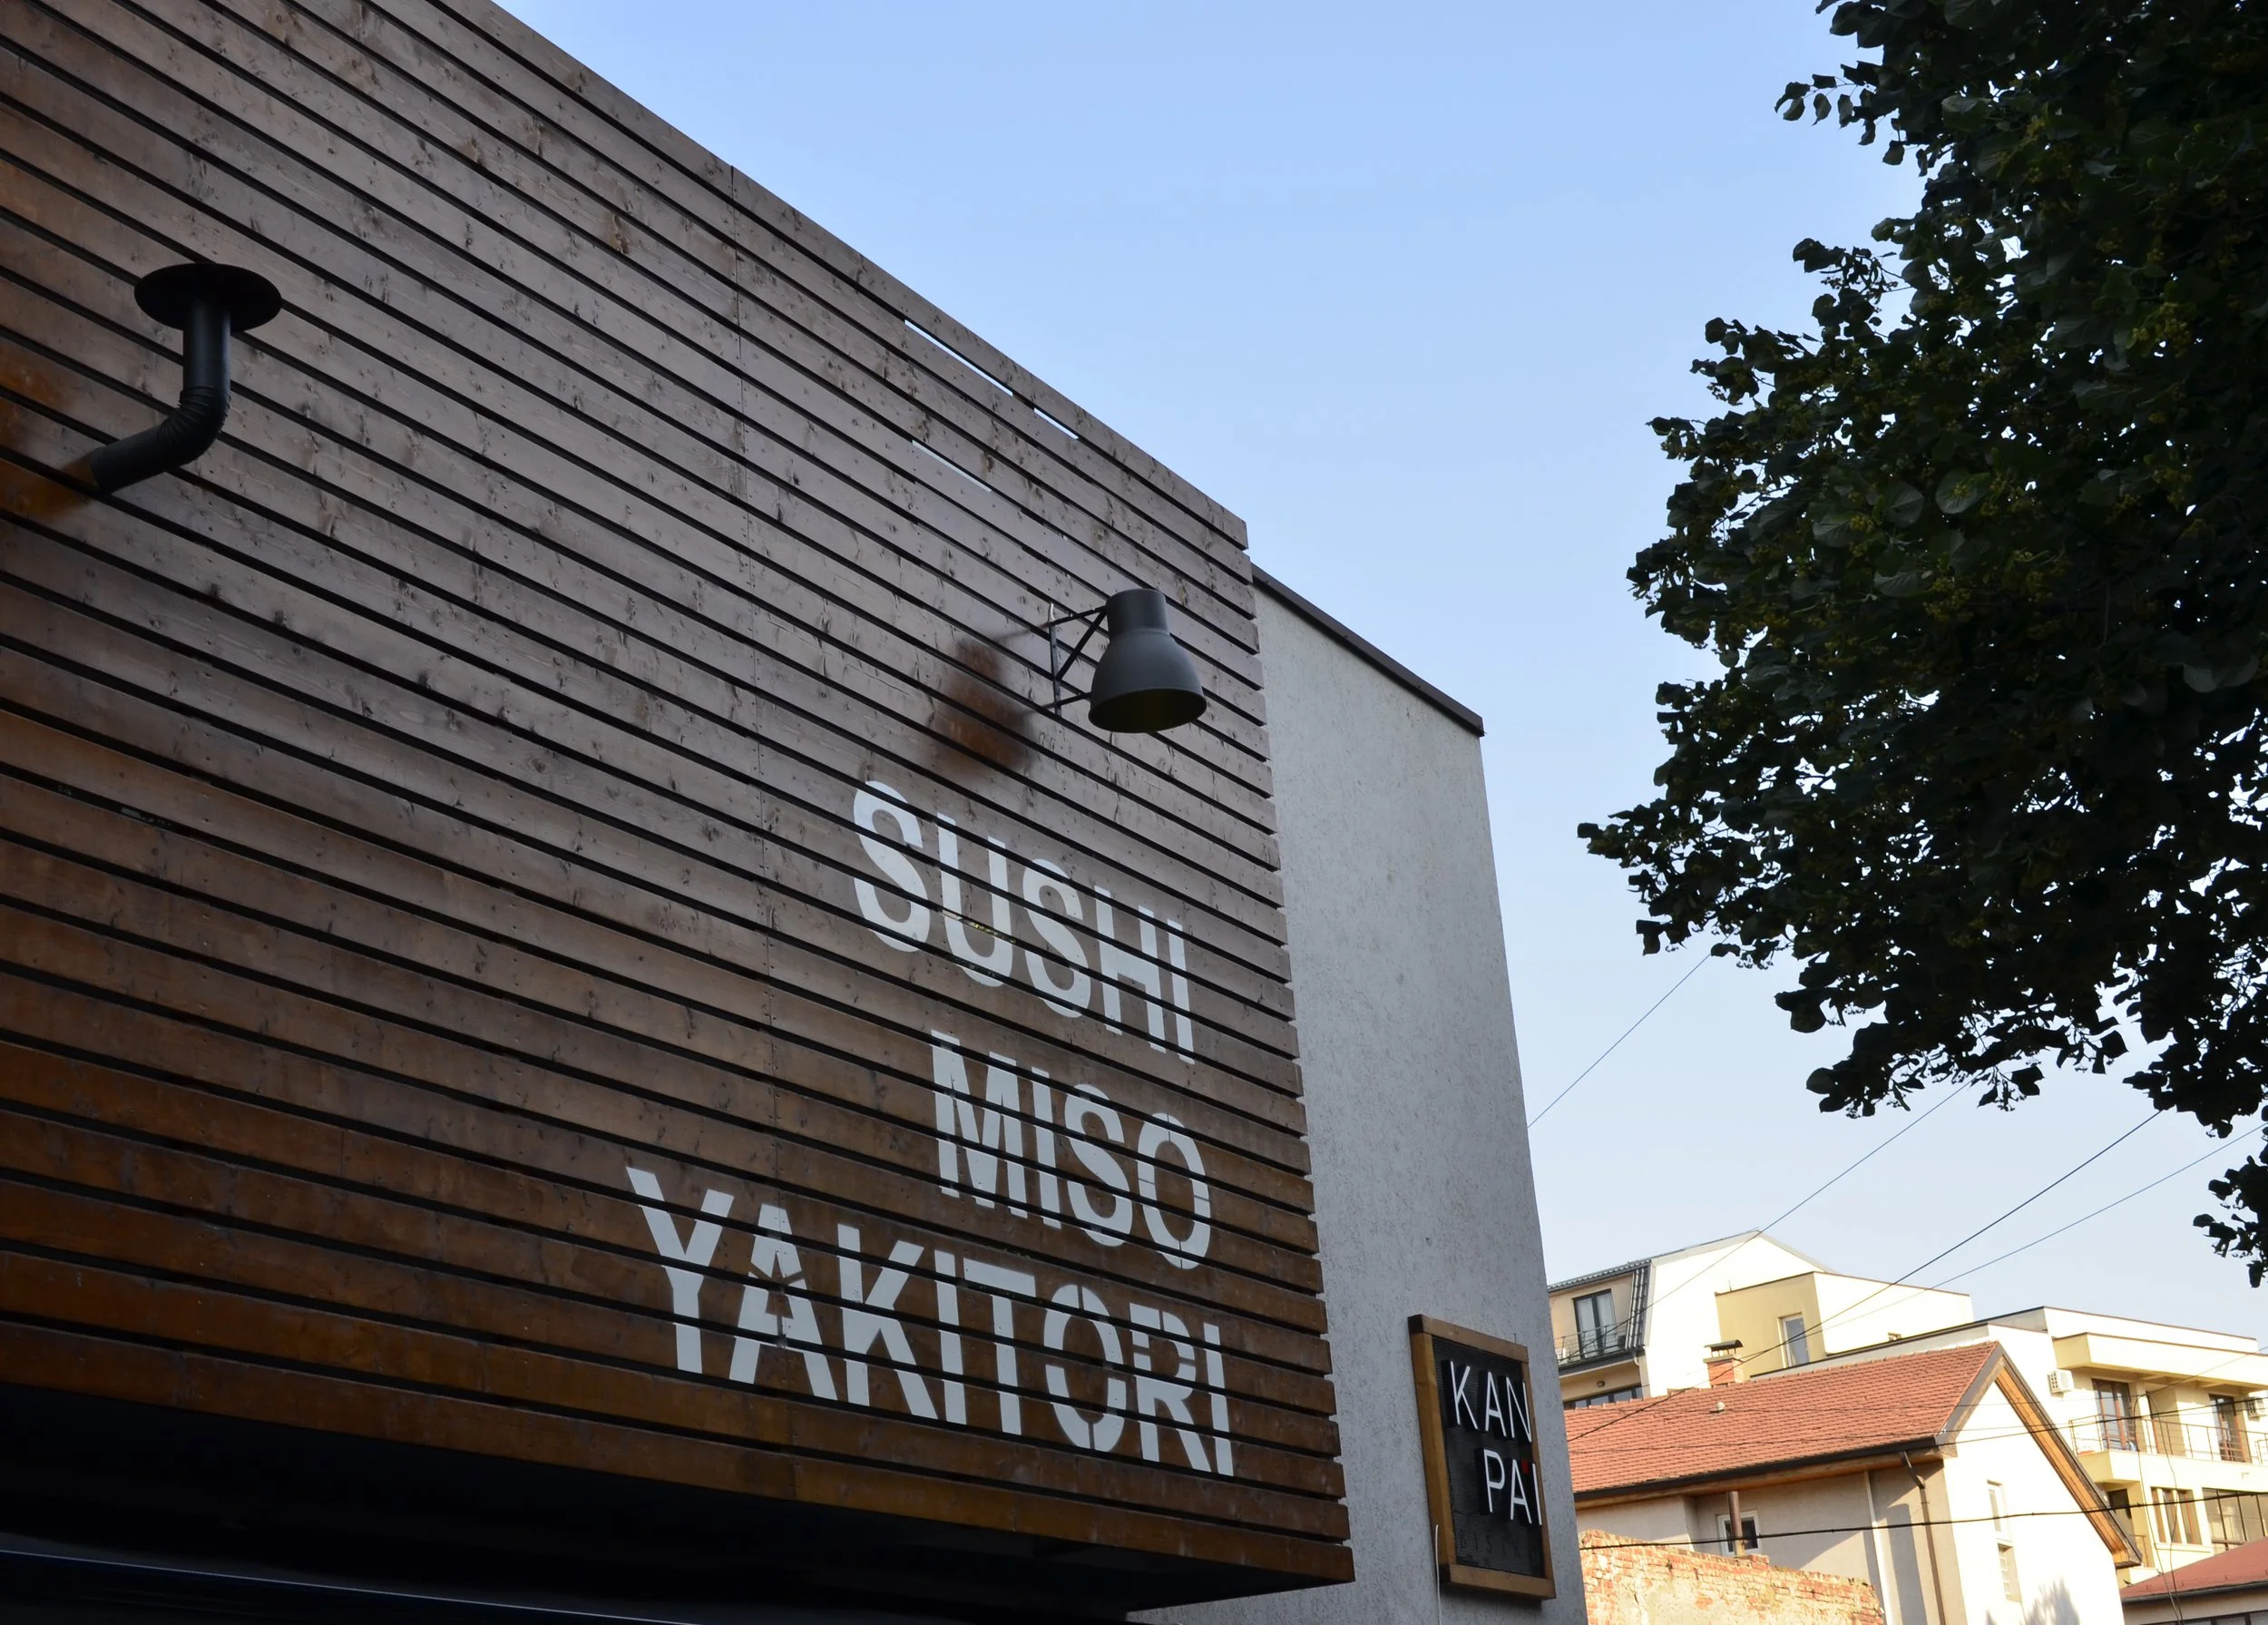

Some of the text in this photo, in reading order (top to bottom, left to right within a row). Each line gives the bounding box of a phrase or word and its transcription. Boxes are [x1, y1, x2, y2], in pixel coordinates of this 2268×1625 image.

[852, 780, 1196, 1065] SUSHI
[930, 1028, 1212, 1270] MISO
[625, 1165, 1236, 1477] YAKITORI
[1450, 1360, 1532, 1444] KAN
[1482, 1448, 1542, 1526] PAI
